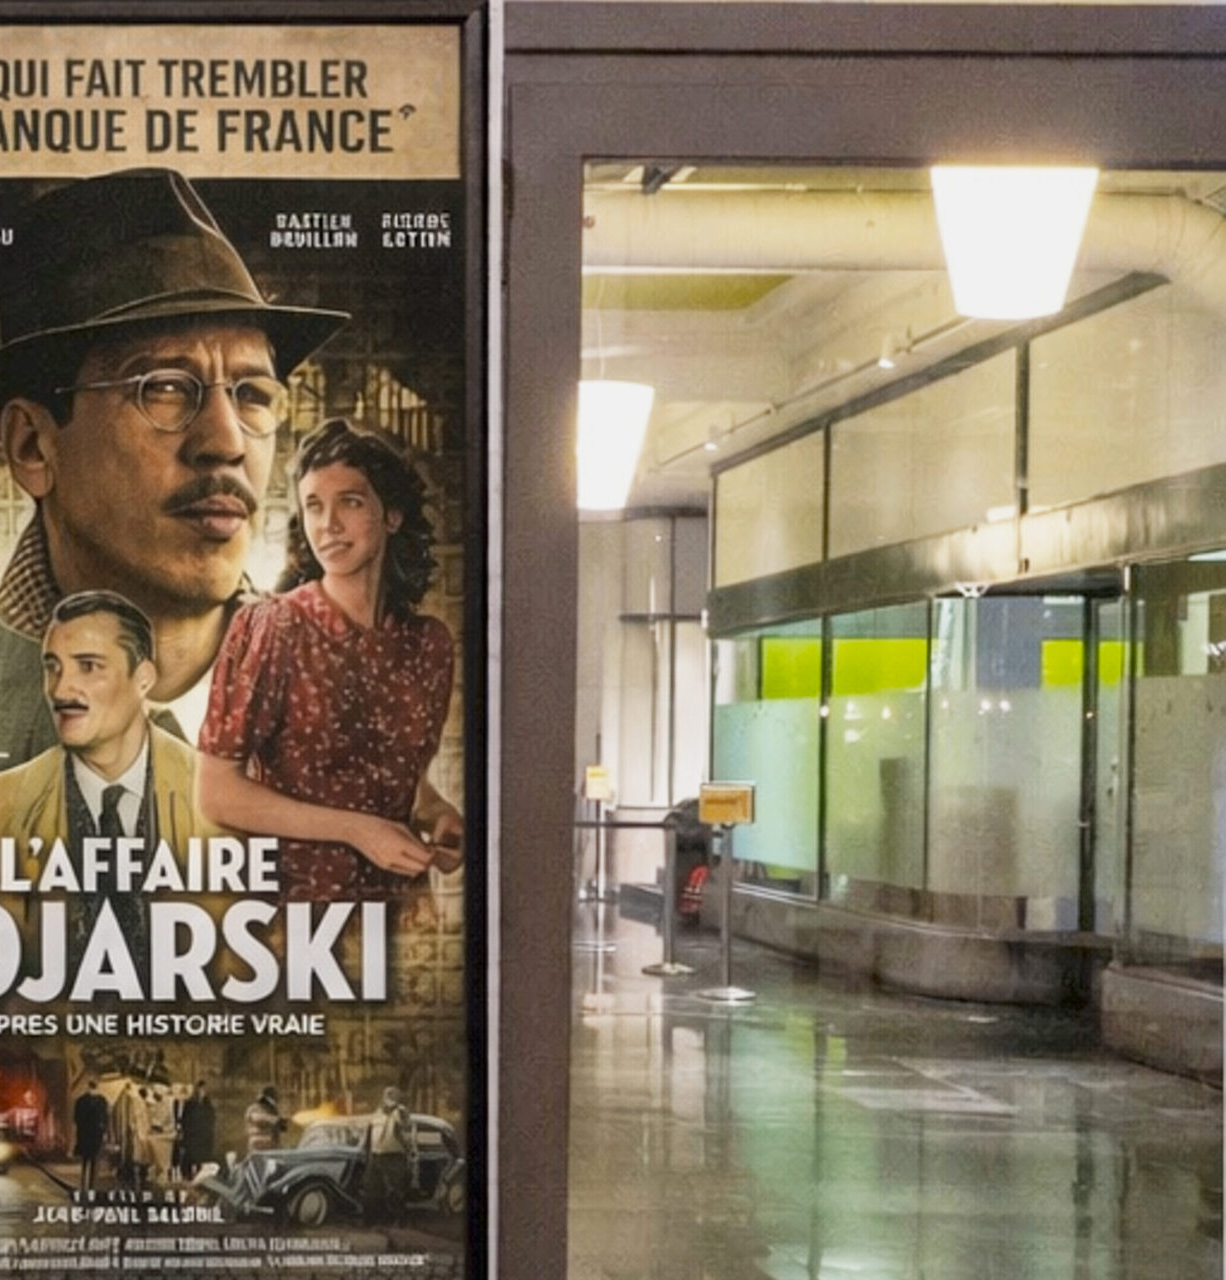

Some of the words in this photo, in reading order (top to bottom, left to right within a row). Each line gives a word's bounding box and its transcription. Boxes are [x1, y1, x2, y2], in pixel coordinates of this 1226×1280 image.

[64, 58, 146, 98] FAIT
[158, 58, 369, 99] TREMBLER
[145, 108, 200, 153] DE
[65, 1014, 120, 1036] UNE
[250, 1014, 326, 1037] VRAIE
